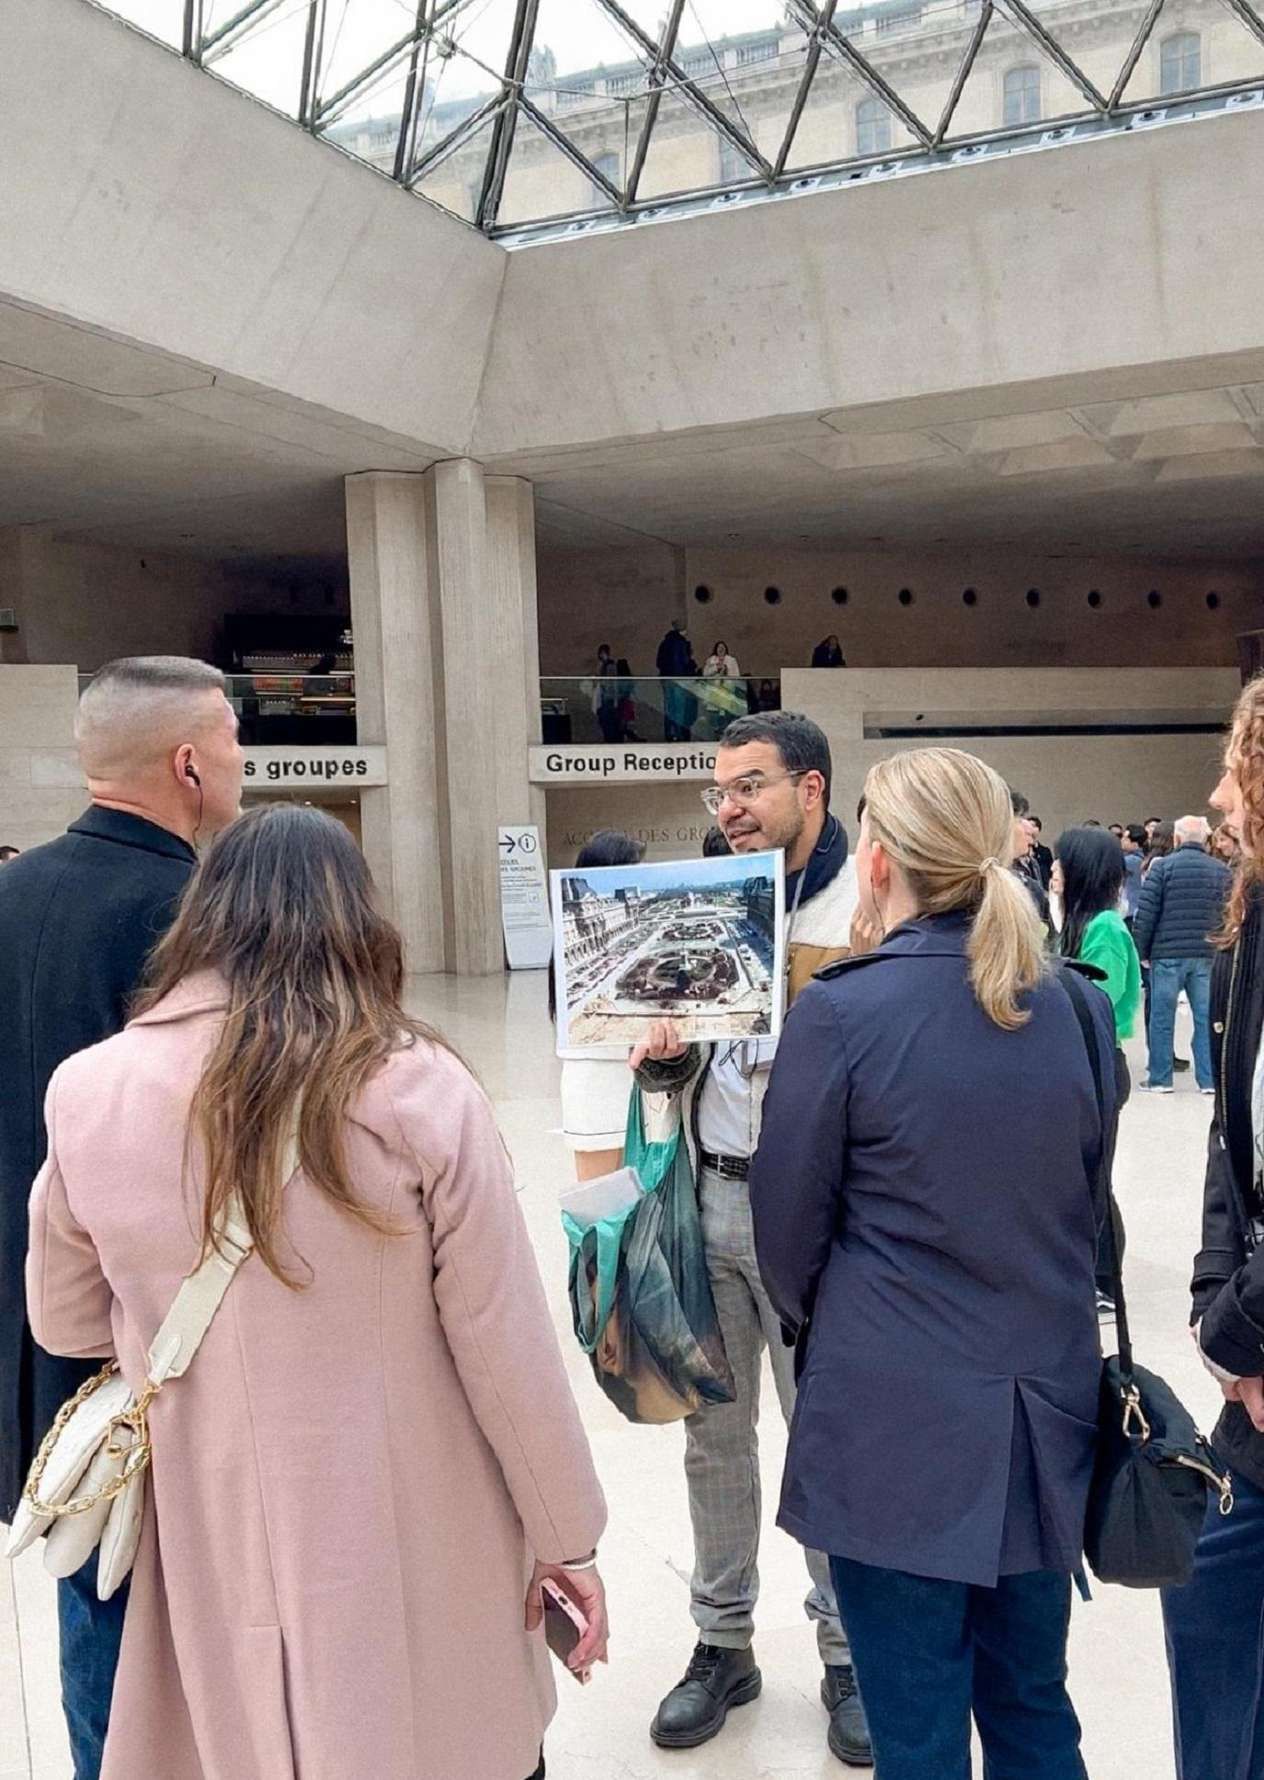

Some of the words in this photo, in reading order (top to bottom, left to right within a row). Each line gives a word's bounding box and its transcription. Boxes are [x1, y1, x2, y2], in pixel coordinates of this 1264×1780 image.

[266, 759, 368, 780] groupes
[546, 753, 616, 777] Group
[624, 751, 717, 776] Receptio
